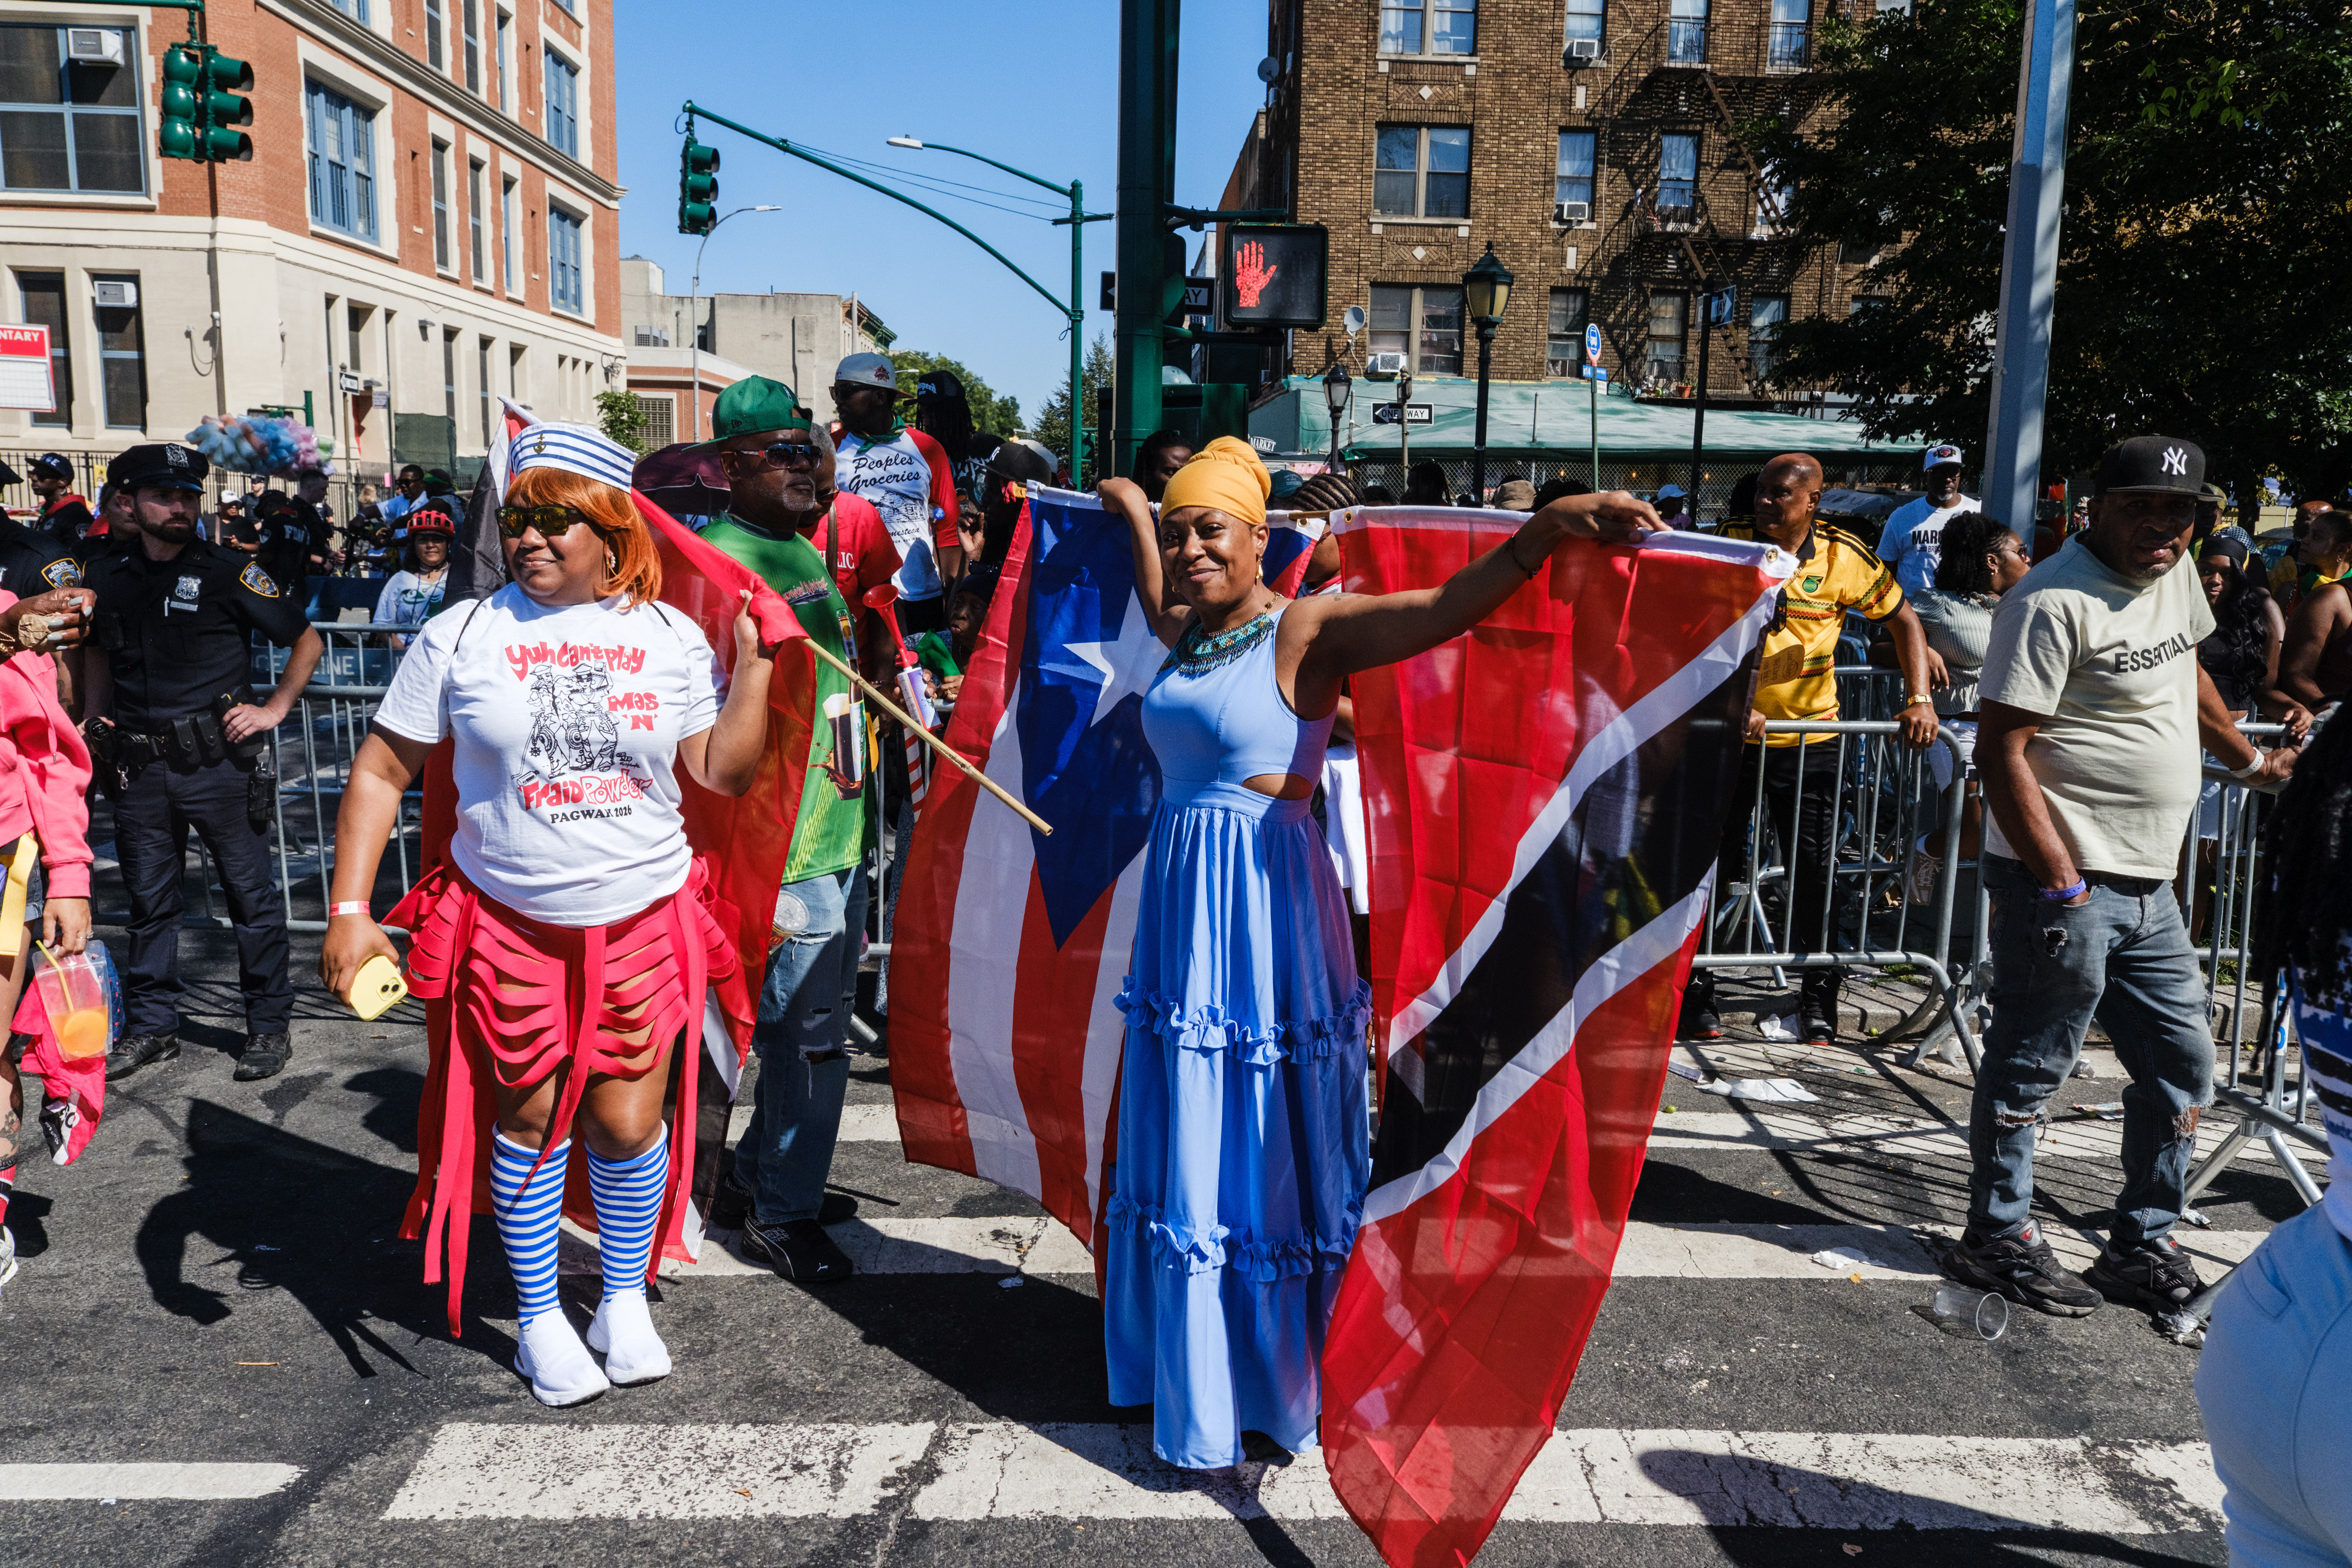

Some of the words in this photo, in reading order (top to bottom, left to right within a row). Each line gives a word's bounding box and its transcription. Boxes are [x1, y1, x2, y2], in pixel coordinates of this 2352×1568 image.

[1185, 289, 1202, 303] AY
[0, 330, 39, 342] NTARY
[1382, 409, 1398, 417] ONE
[1407, 410, 1425, 418] WAY
[1250, 437, 1276, 452] MARKET
[853, 453, 914, 474] Peoples
[848, 470, 921, 494] Groceries
[889, 526, 920, 536] mestead
[818, 550, 855, 569] HLIC
[783, 580, 804, 601] arnival
[255, 654, 283, 674] CE
[614, 804, 632, 817] 2026
